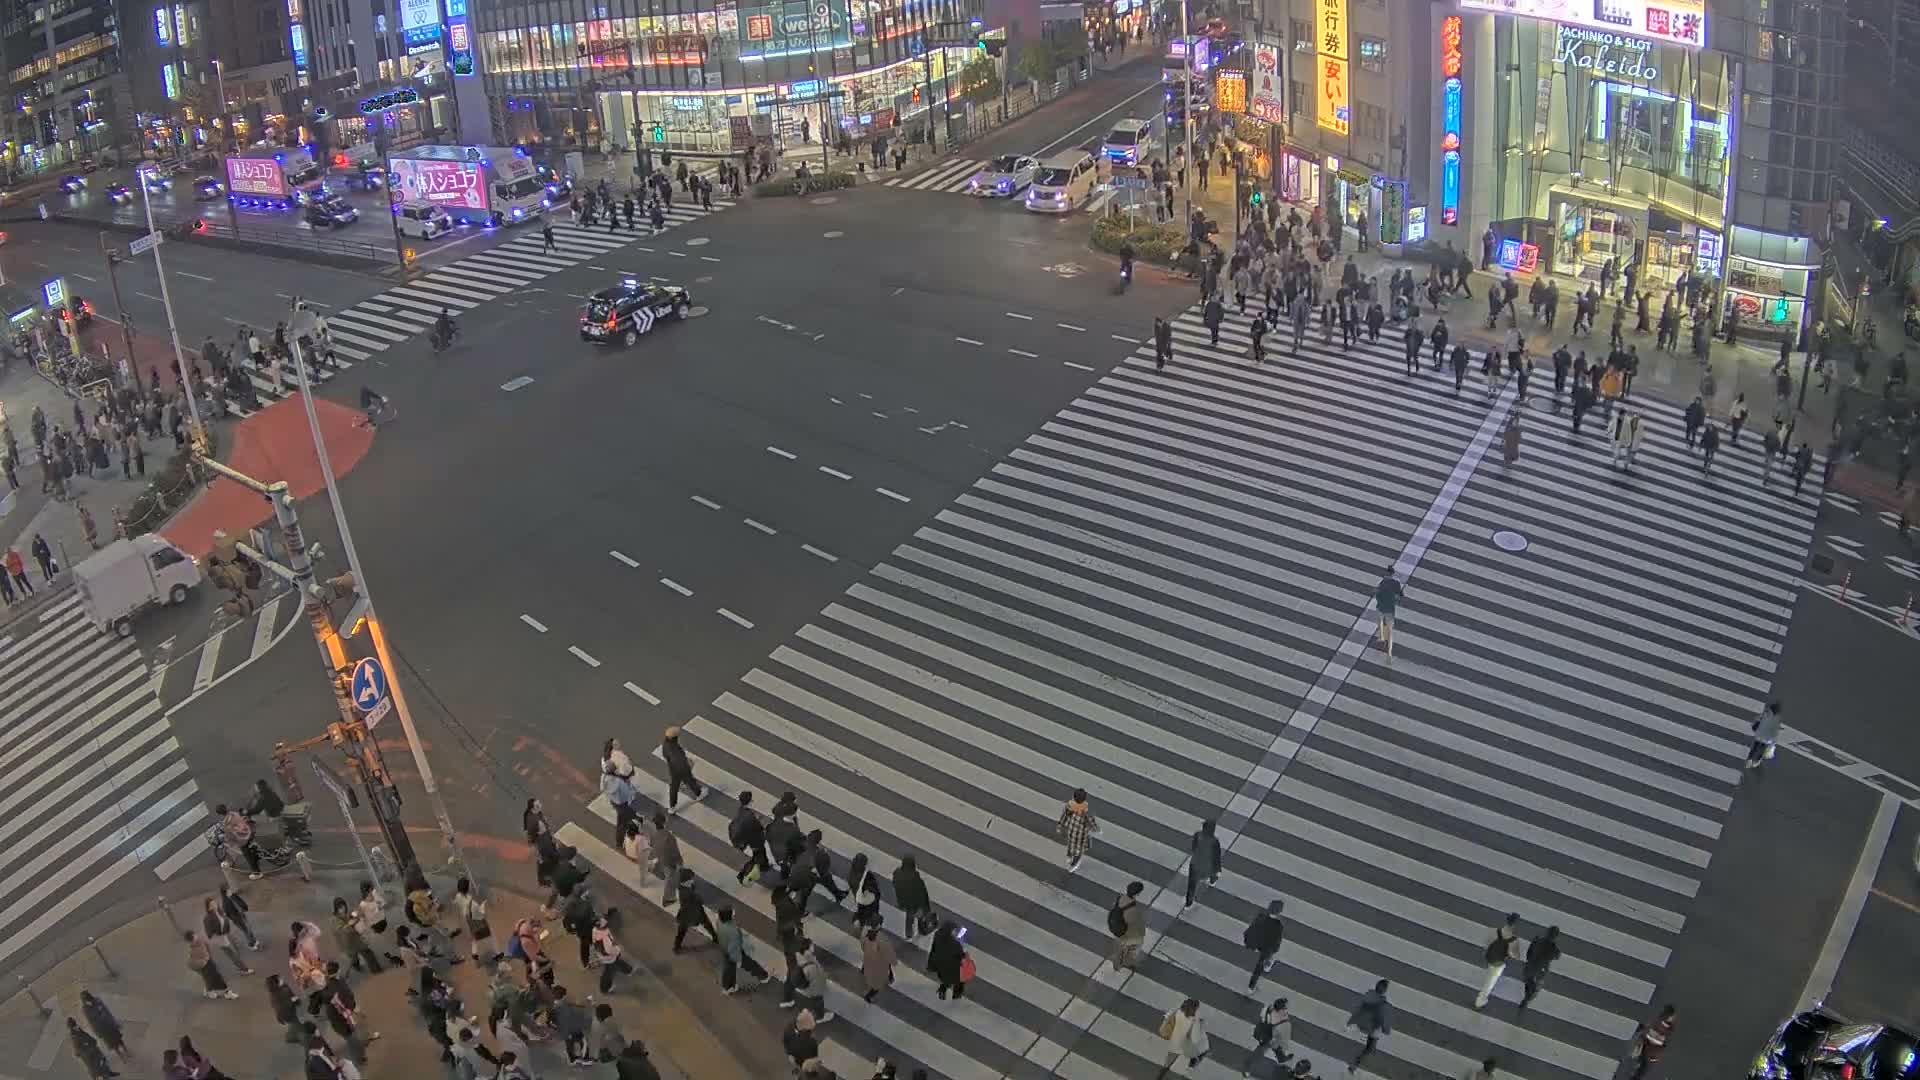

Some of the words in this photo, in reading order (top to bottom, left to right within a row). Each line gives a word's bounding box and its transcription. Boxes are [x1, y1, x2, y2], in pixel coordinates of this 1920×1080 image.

[1558, 26, 1613, 45] PACHINKO
[1614, 35, 1623, 46] &
[1625, 37, 1653, 51] SLOT
[1552, 39, 1657, 80] Kaleido
